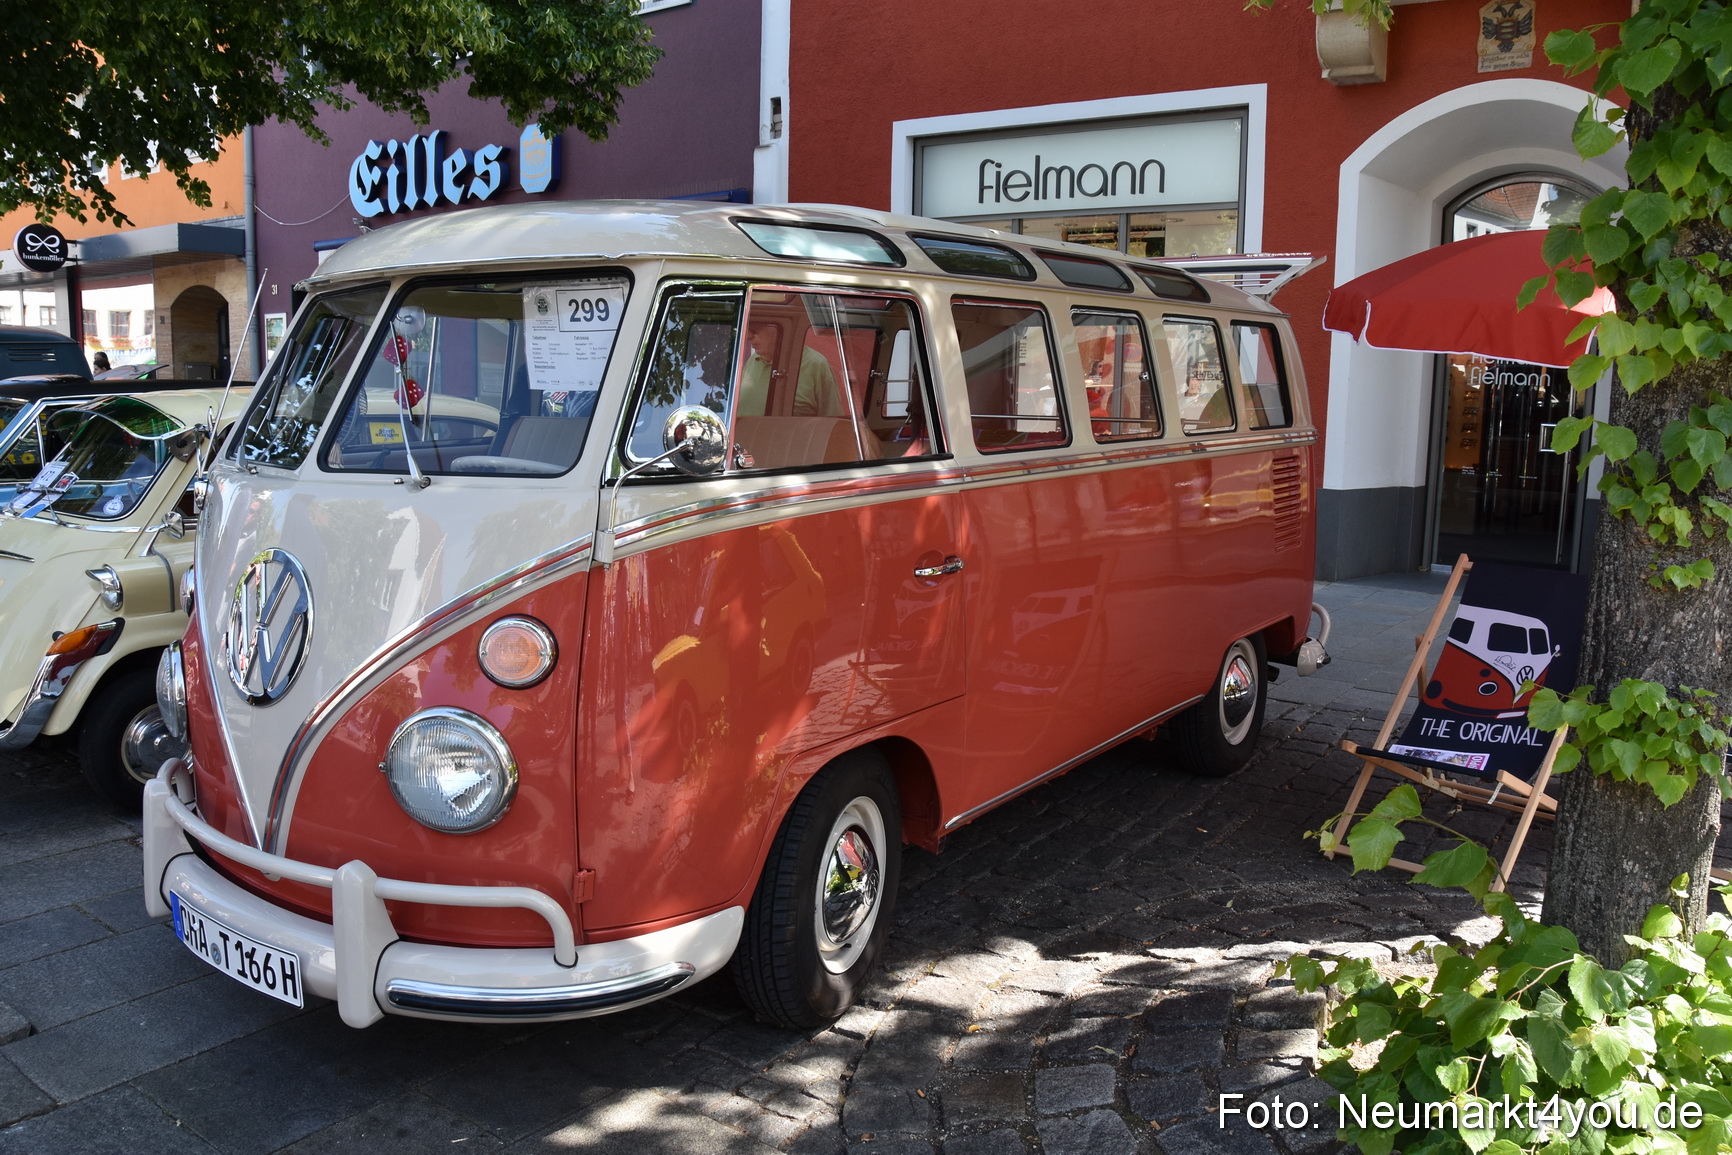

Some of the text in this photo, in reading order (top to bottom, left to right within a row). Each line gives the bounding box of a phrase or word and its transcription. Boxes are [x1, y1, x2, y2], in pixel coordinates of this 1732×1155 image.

[349, 129, 503, 218] Eilles
[22, 252, 65, 262] hunkemöller
[271, 284, 278, 295] 31
[568, 297, 610, 323] 299
[1420, 717, 1543, 747] THE ORIGINAL
[180, 904, 210, 957] CHA
